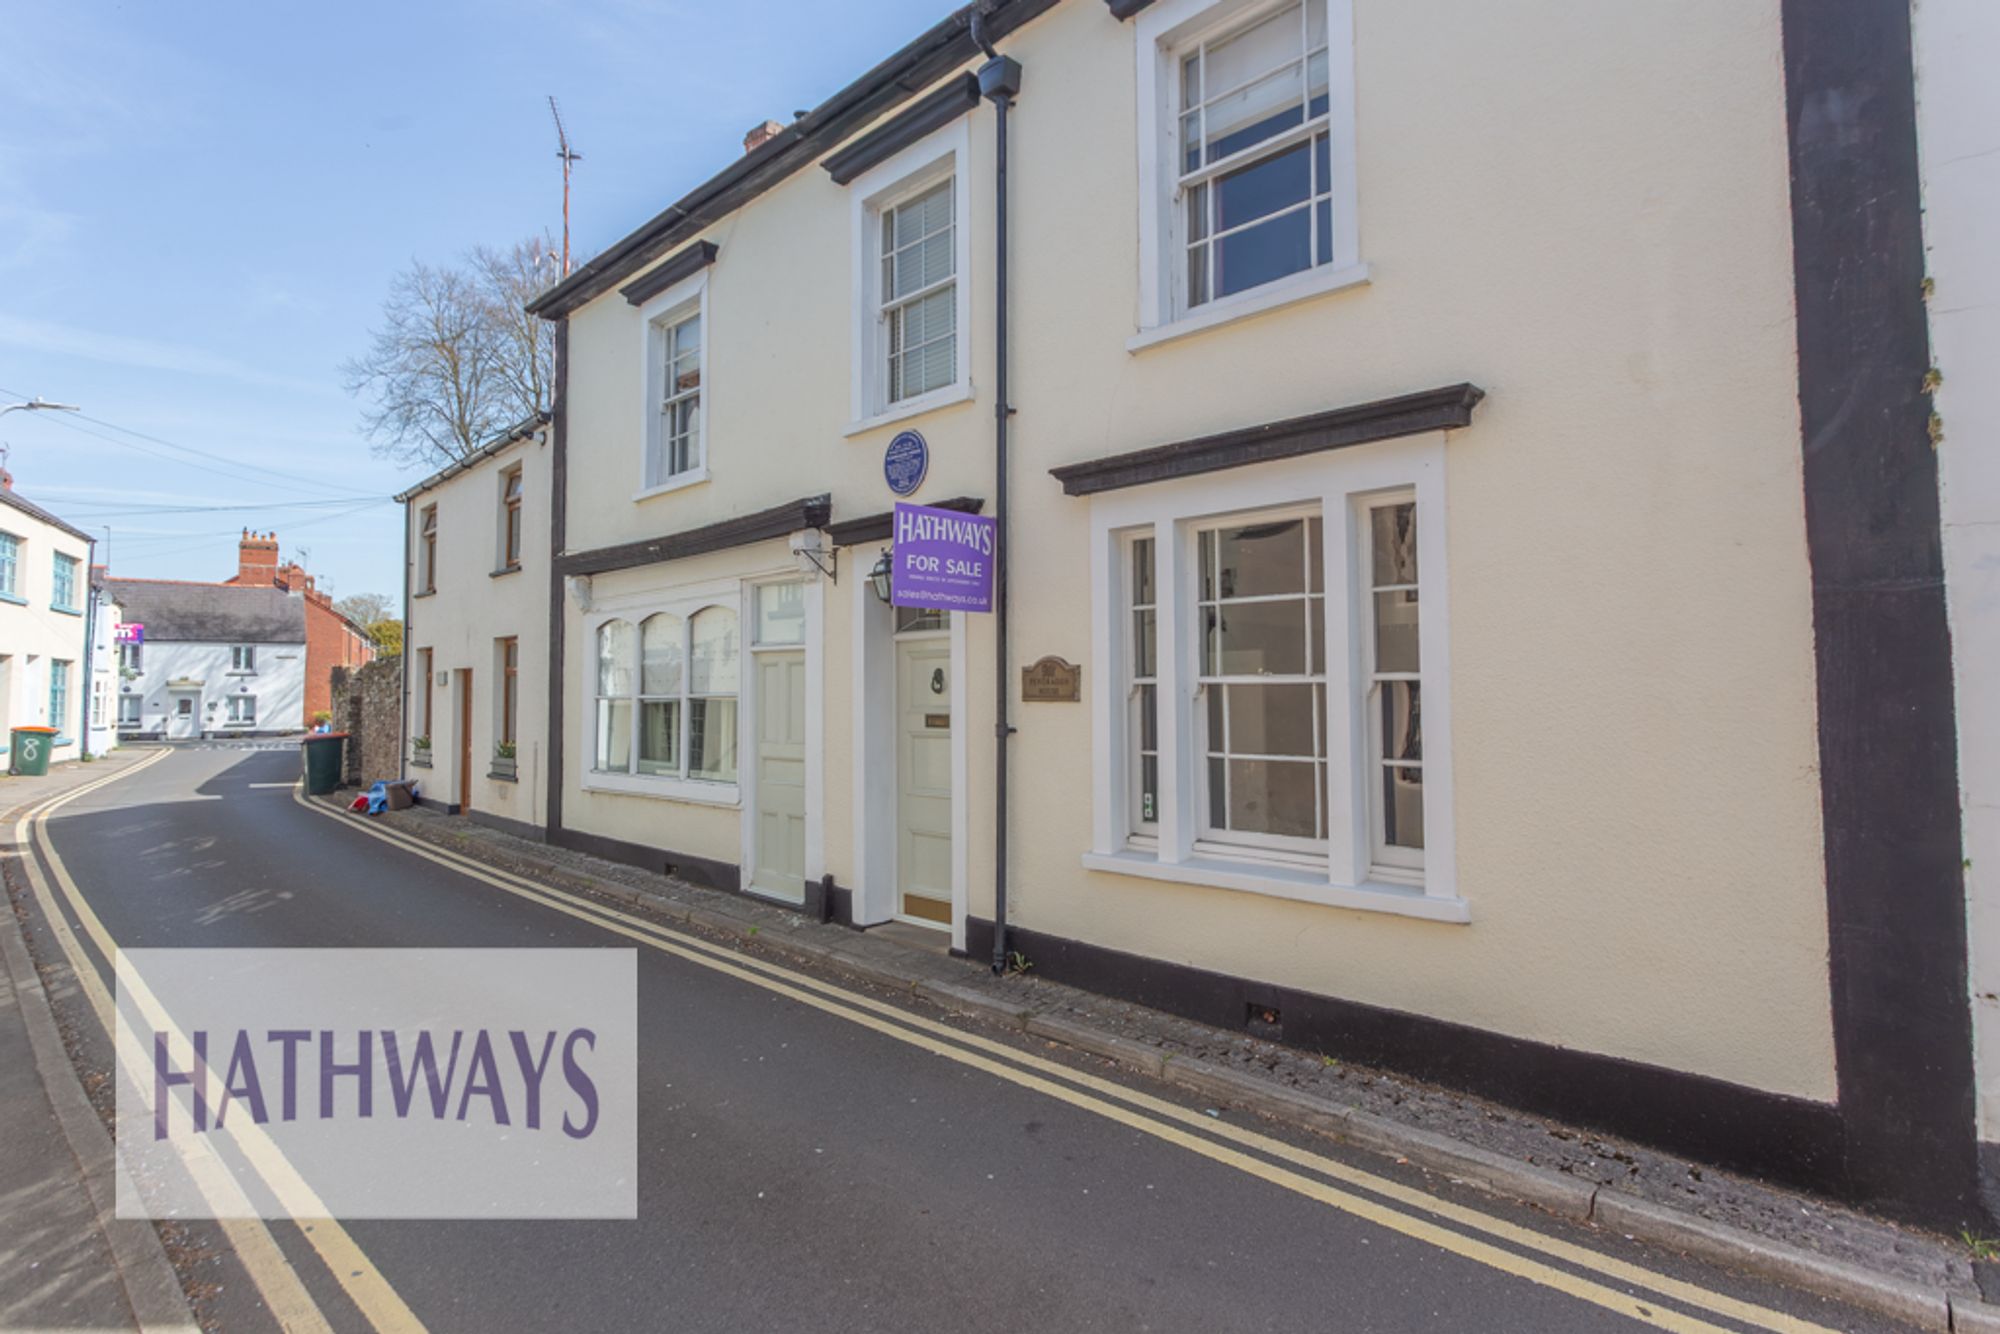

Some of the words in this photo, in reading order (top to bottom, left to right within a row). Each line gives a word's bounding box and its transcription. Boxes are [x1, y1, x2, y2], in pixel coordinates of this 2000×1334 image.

[898, 511, 992, 556] HATHWAYS
[906, 554, 940, 572] FOR
[946, 559, 982, 577] SALE
[897, 590, 987, 605] sales@hathways.co.uk
[23, 738, 40, 761] 8
